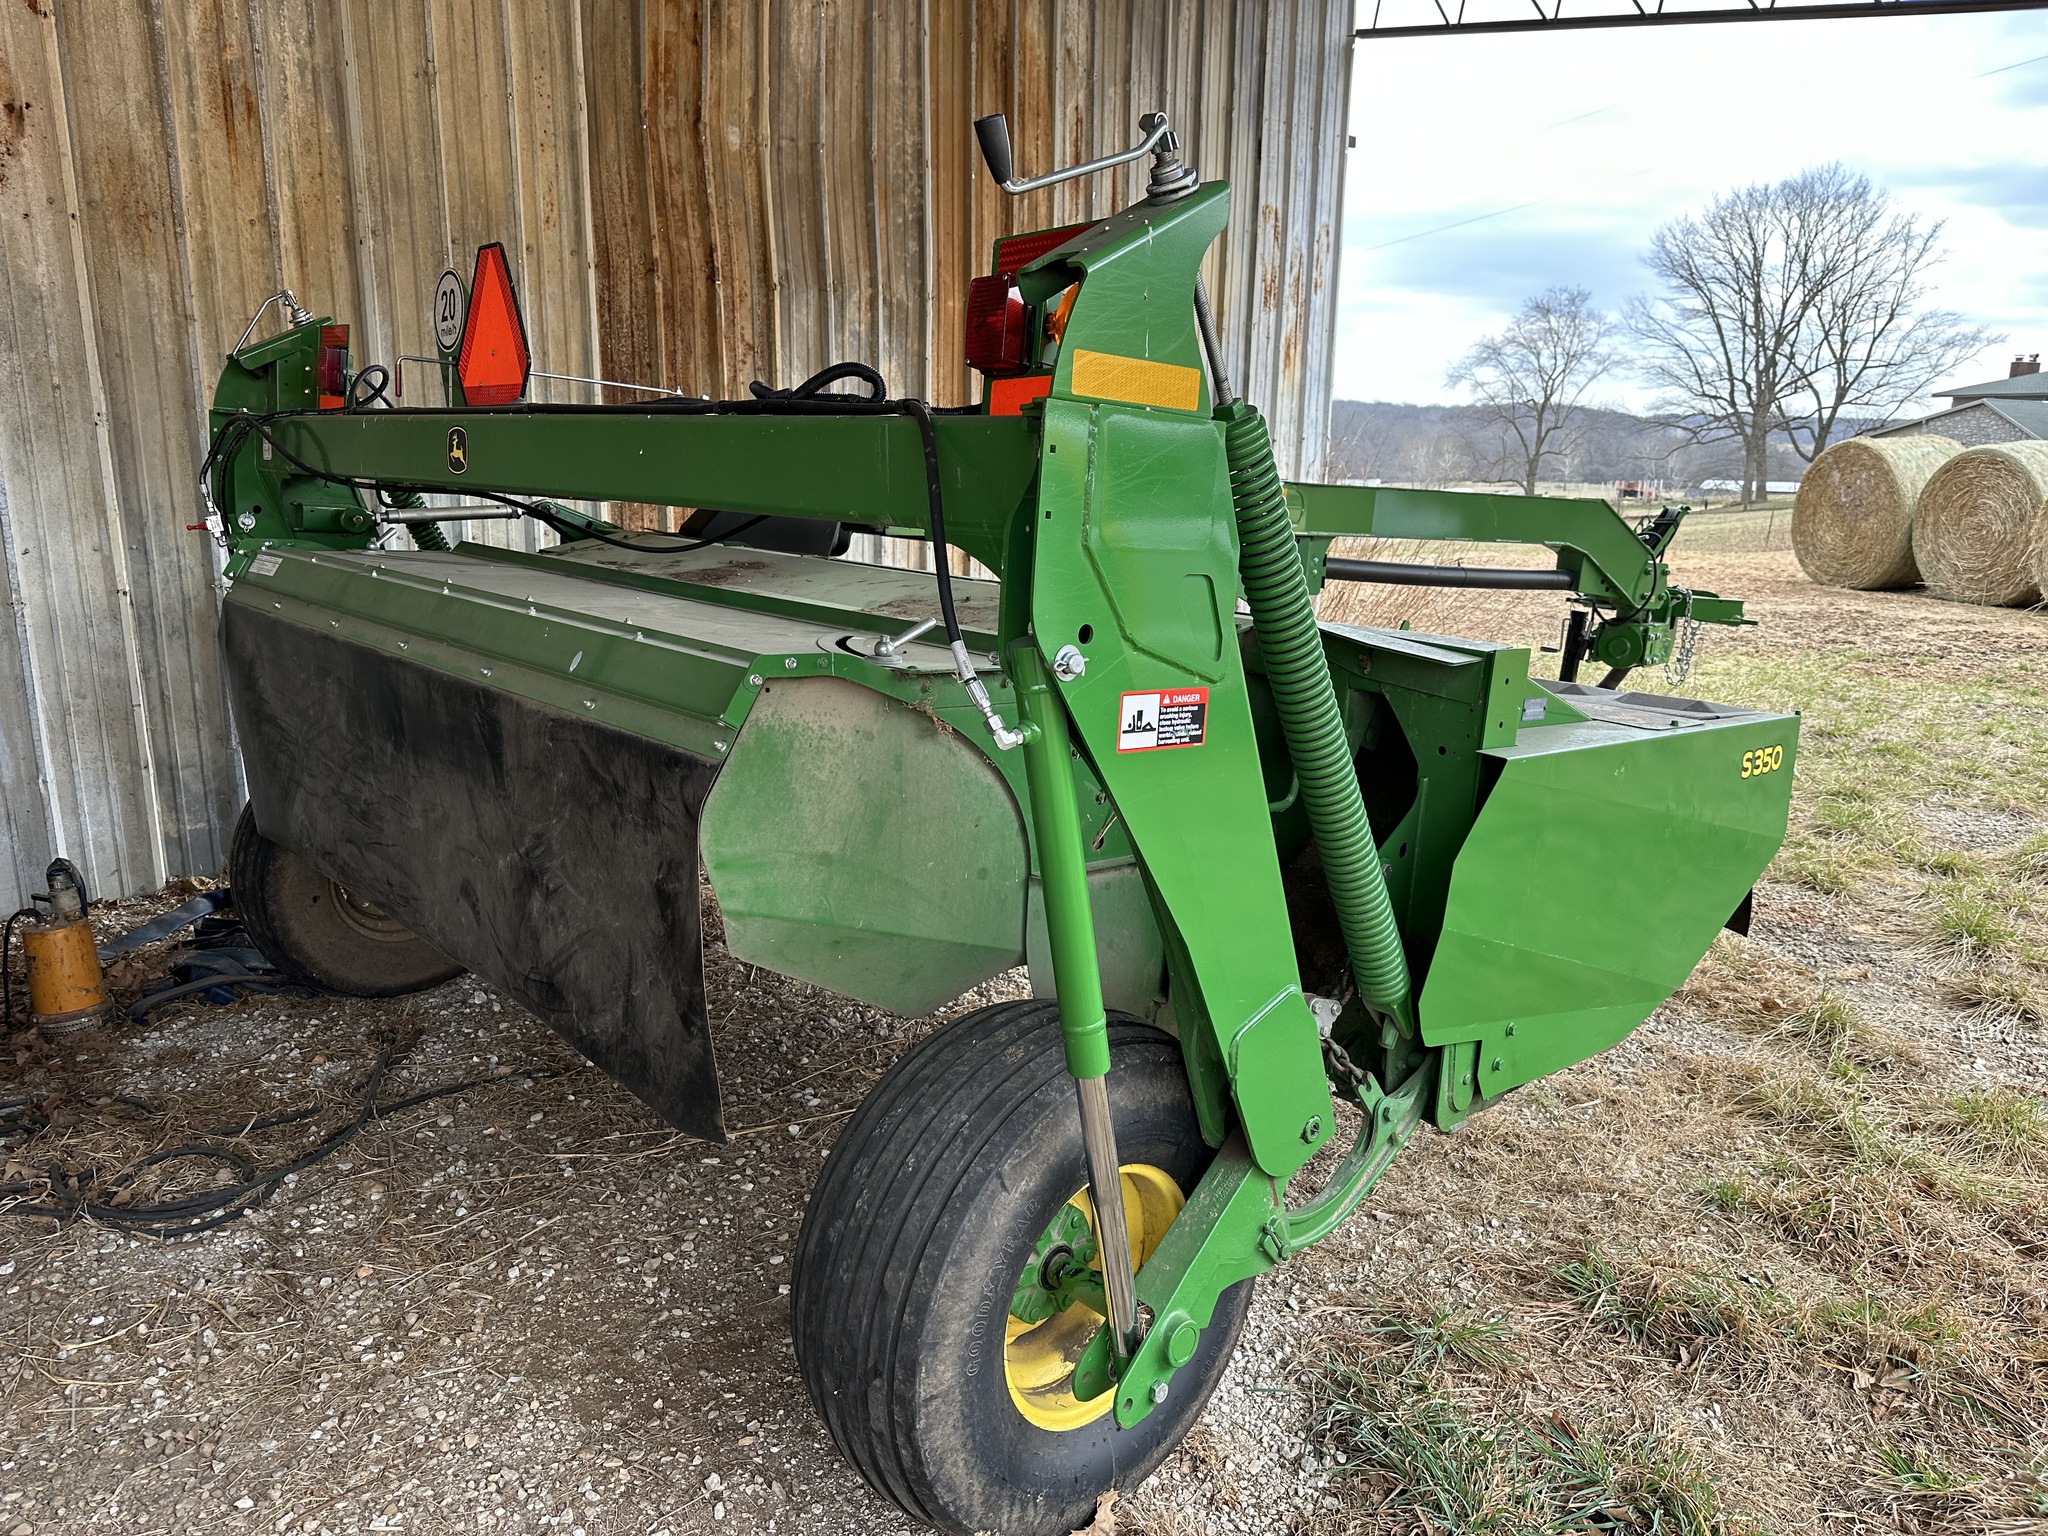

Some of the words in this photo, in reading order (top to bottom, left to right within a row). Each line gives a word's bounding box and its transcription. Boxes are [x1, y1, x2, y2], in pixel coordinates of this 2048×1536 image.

[441, 288, 456, 323] 20
[1173, 694, 1200, 704] DANGER
[1740, 744, 1783, 779] S350
[966, 1199, 1041, 1377] GOODYEAR
